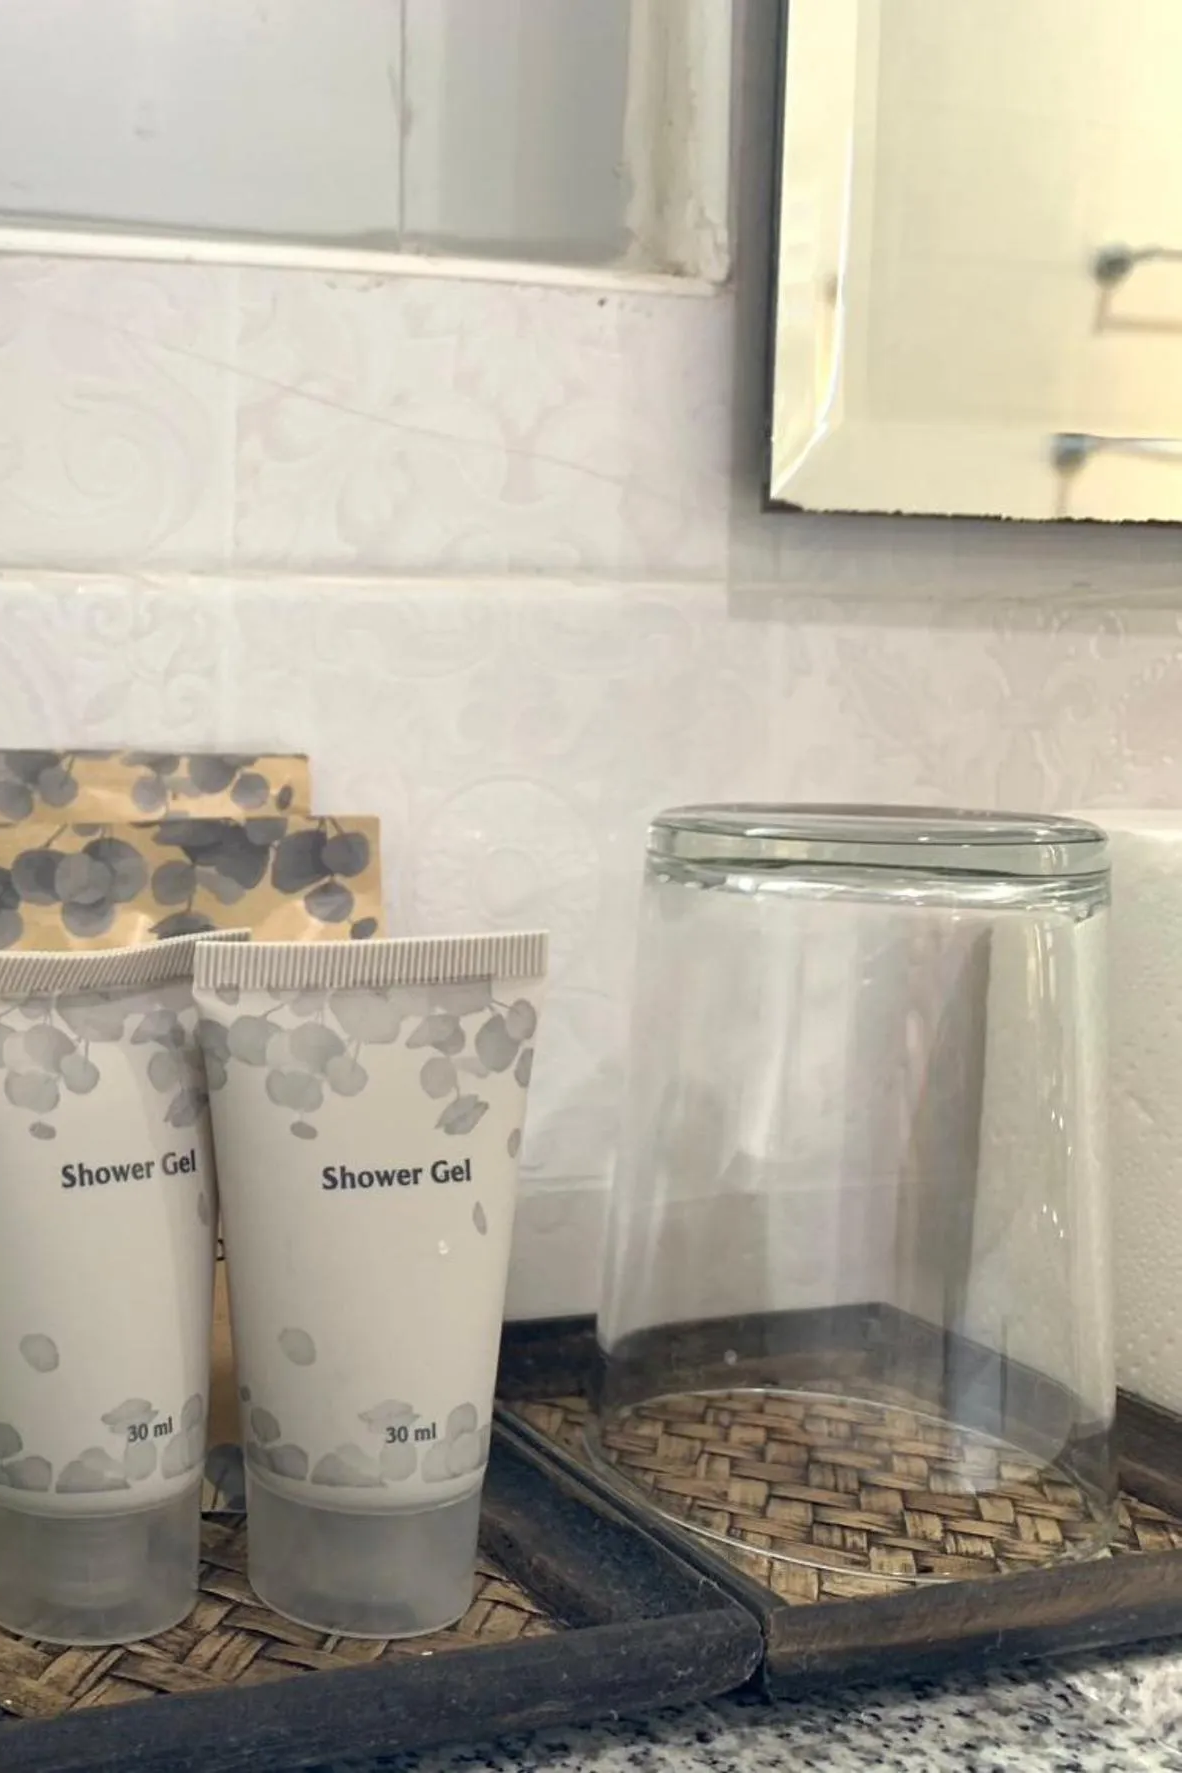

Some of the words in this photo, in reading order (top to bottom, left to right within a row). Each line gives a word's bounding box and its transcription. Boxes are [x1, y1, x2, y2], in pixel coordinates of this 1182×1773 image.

[60, 1159, 155, 1188] Shower
[161, 1150, 197, 1174] Gel
[322, 1162, 423, 1190] Shower
[430, 1159, 472, 1183] Gel
[127, 1423, 151, 1442] 30
[154, 1417, 173, 1437] ml
[386, 1425, 411, 1443] 30
[416, 1423, 437, 1441] ml
